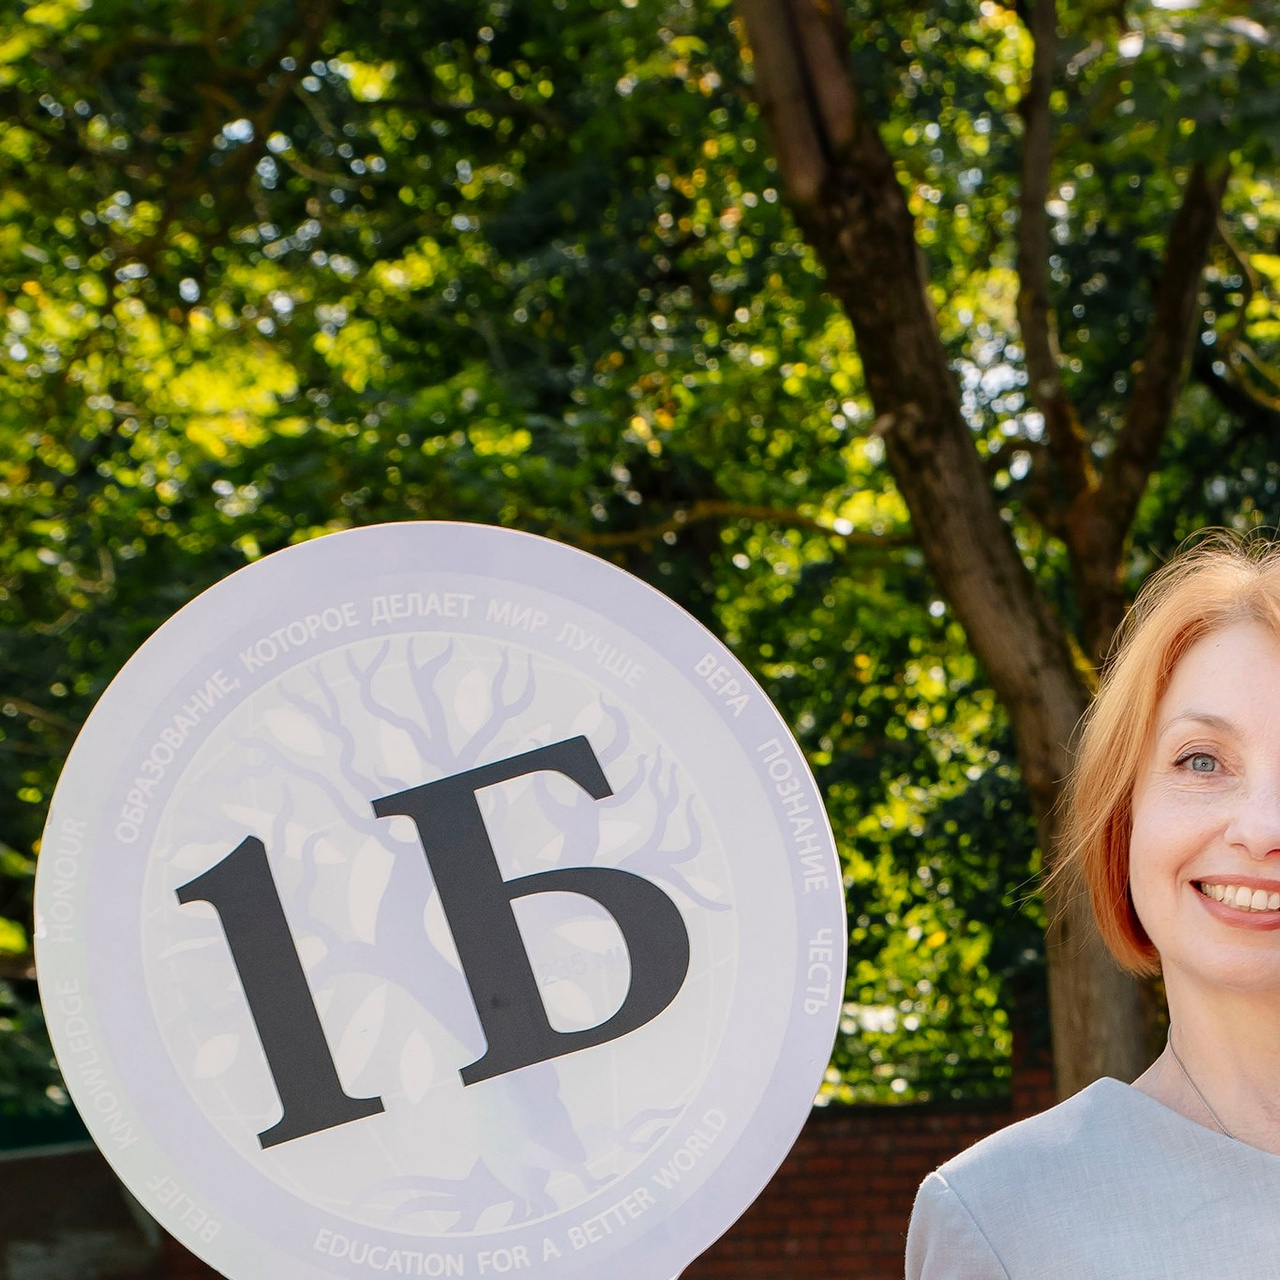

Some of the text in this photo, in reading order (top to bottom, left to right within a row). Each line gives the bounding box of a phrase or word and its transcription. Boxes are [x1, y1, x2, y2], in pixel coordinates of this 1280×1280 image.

[114, 592, 649, 844] ОБРАЗОВАНИЕ, КОТОРОЕ ДЕЛАЕТ МИР ЛУЧШЕ
[694, 652, 833, 1016] ВЕРА ПОЗНАНИЕ ЧЕСТЬ
[49, 816, 222, 1244] BELIEF KNOWLEDGE HONOUR
[174, 734, 692, 1151] 1Б
[312, 1106, 728, 1278] EDUCATION FOR A BETTER WORLD
